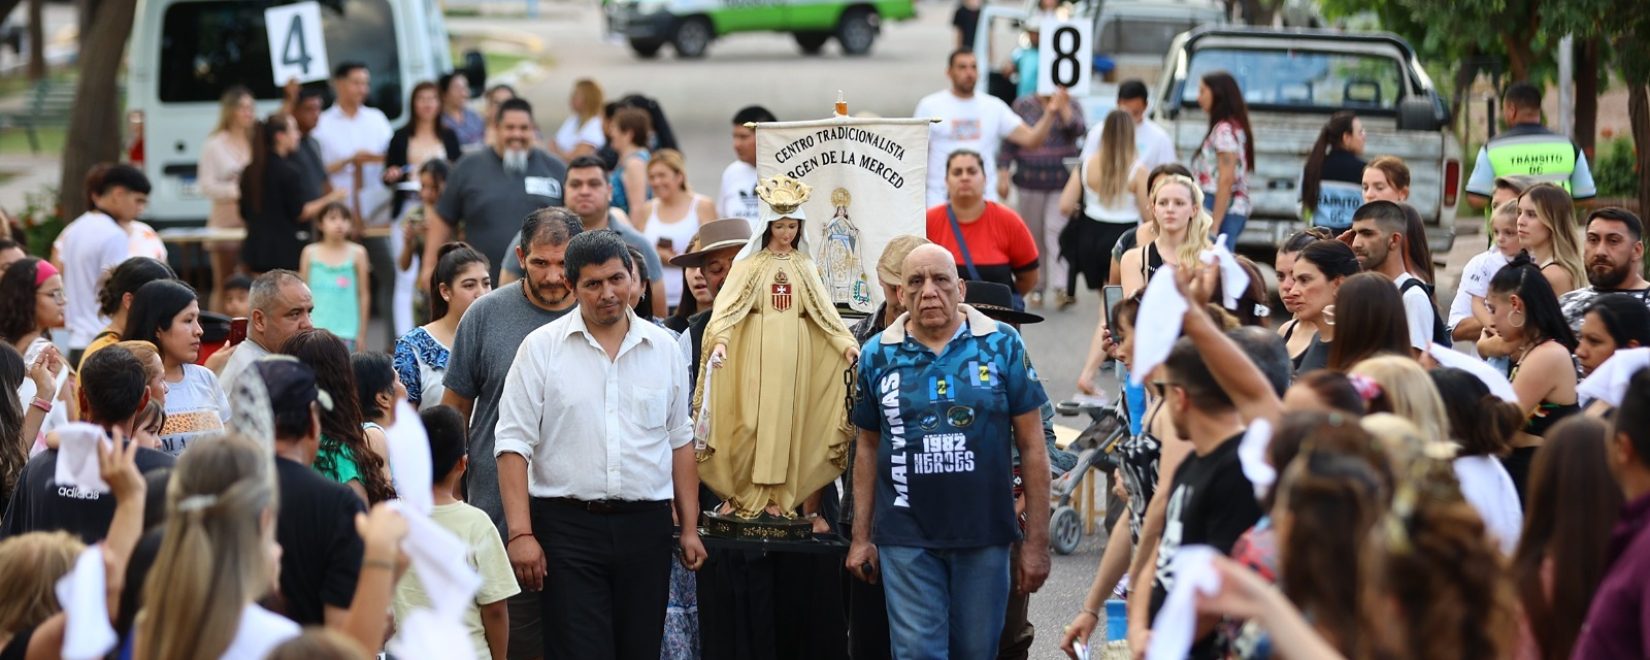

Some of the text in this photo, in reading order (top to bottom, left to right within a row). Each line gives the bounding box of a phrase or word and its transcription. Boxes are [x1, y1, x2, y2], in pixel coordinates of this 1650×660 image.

[282, 14, 313, 75] 4
[1052, 26, 1081, 88] 8
[775, 126, 906, 164] CENTRO TRADICIONALISTA
[786, 150, 905, 190] RGEN DE LA MERCED
[881, 372, 910, 508] MALVINAS
[922, 435, 966, 453] 1982
[914, 451, 975, 474] HEROES
